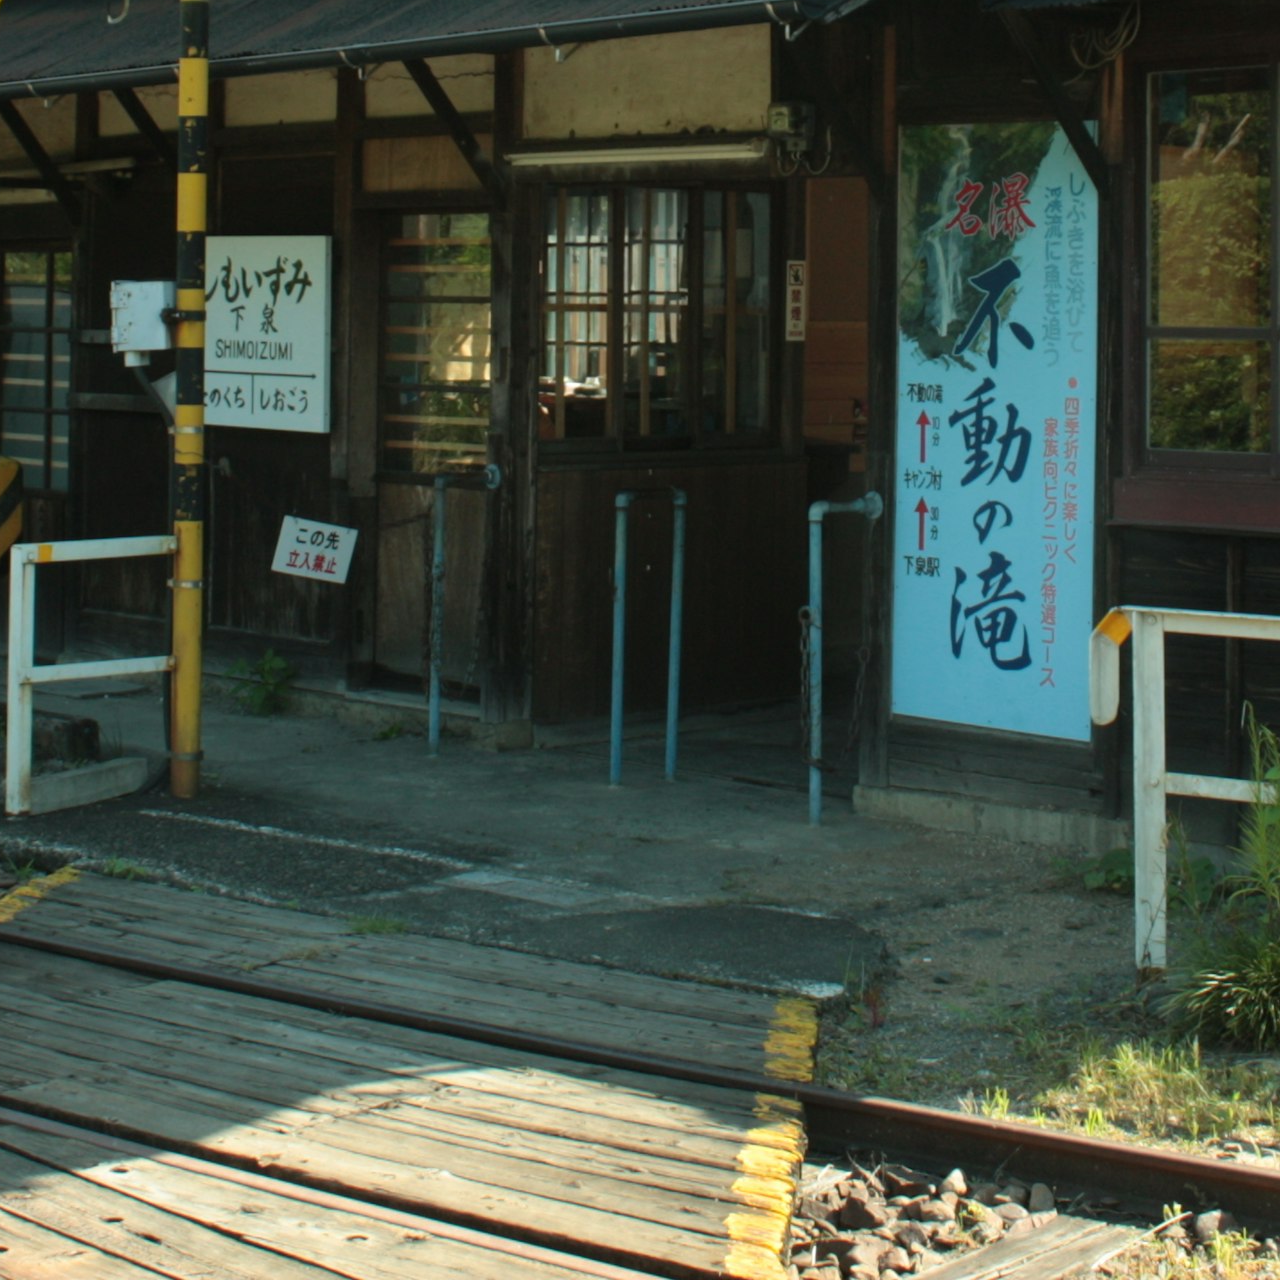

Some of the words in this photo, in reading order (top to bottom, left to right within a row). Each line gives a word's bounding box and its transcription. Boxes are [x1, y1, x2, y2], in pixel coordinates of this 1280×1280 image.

[945, 172, 1037, 241] 名瀑
[1065, 171, 1086, 354] しぶきを浴びて
[230, 304, 279, 335] 下泉
[215, 339, 294, 361] SHIMOIZUMI
[259, 386, 310, 414] しおごう
[906, 382, 944, 404] 不動の滝
[948, 257, 1035, 671] 不動の滝
[903, 466, 943, 491] キャンプ村
[1063, 396, 1080, 564] 四季折々に楽しく
[296, 528, 340, 550] この先
[285, 549, 337, 575] 立入禁止
[903, 555, 941, 578] 下泉駅
